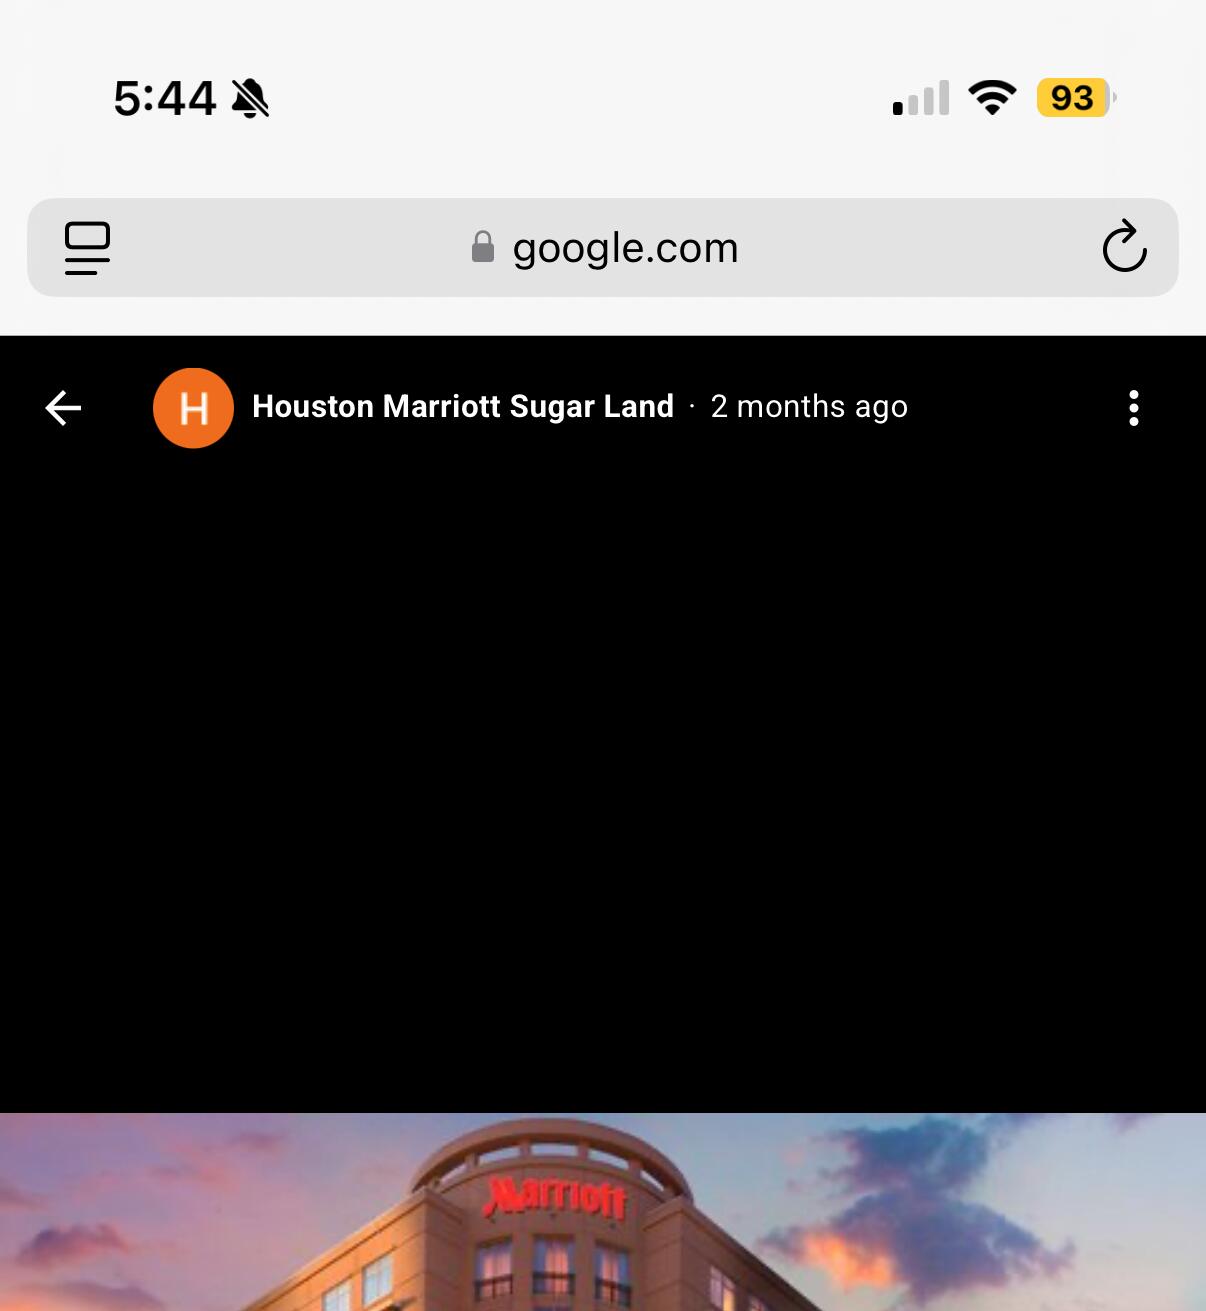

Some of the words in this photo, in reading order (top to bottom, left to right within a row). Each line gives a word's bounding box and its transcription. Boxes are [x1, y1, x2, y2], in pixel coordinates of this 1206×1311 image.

[114, 81, 218, 116] 5:44
[1051, 85, 1094, 111] 93
[513, 231, 738, 271] google.com
[182, 393, 207, 425] H
[253, 393, 374, 419] Houston
[383, 393, 501, 419] Marriott
[509, 393, 596, 425] Sugar
[604, 393, 674, 418] Land
[711, 393, 728, 418] 2
[737, 393, 845, 419] months
[855, 399, 908, 425] ago
[482, 1175, 626, 1220] Marriott
